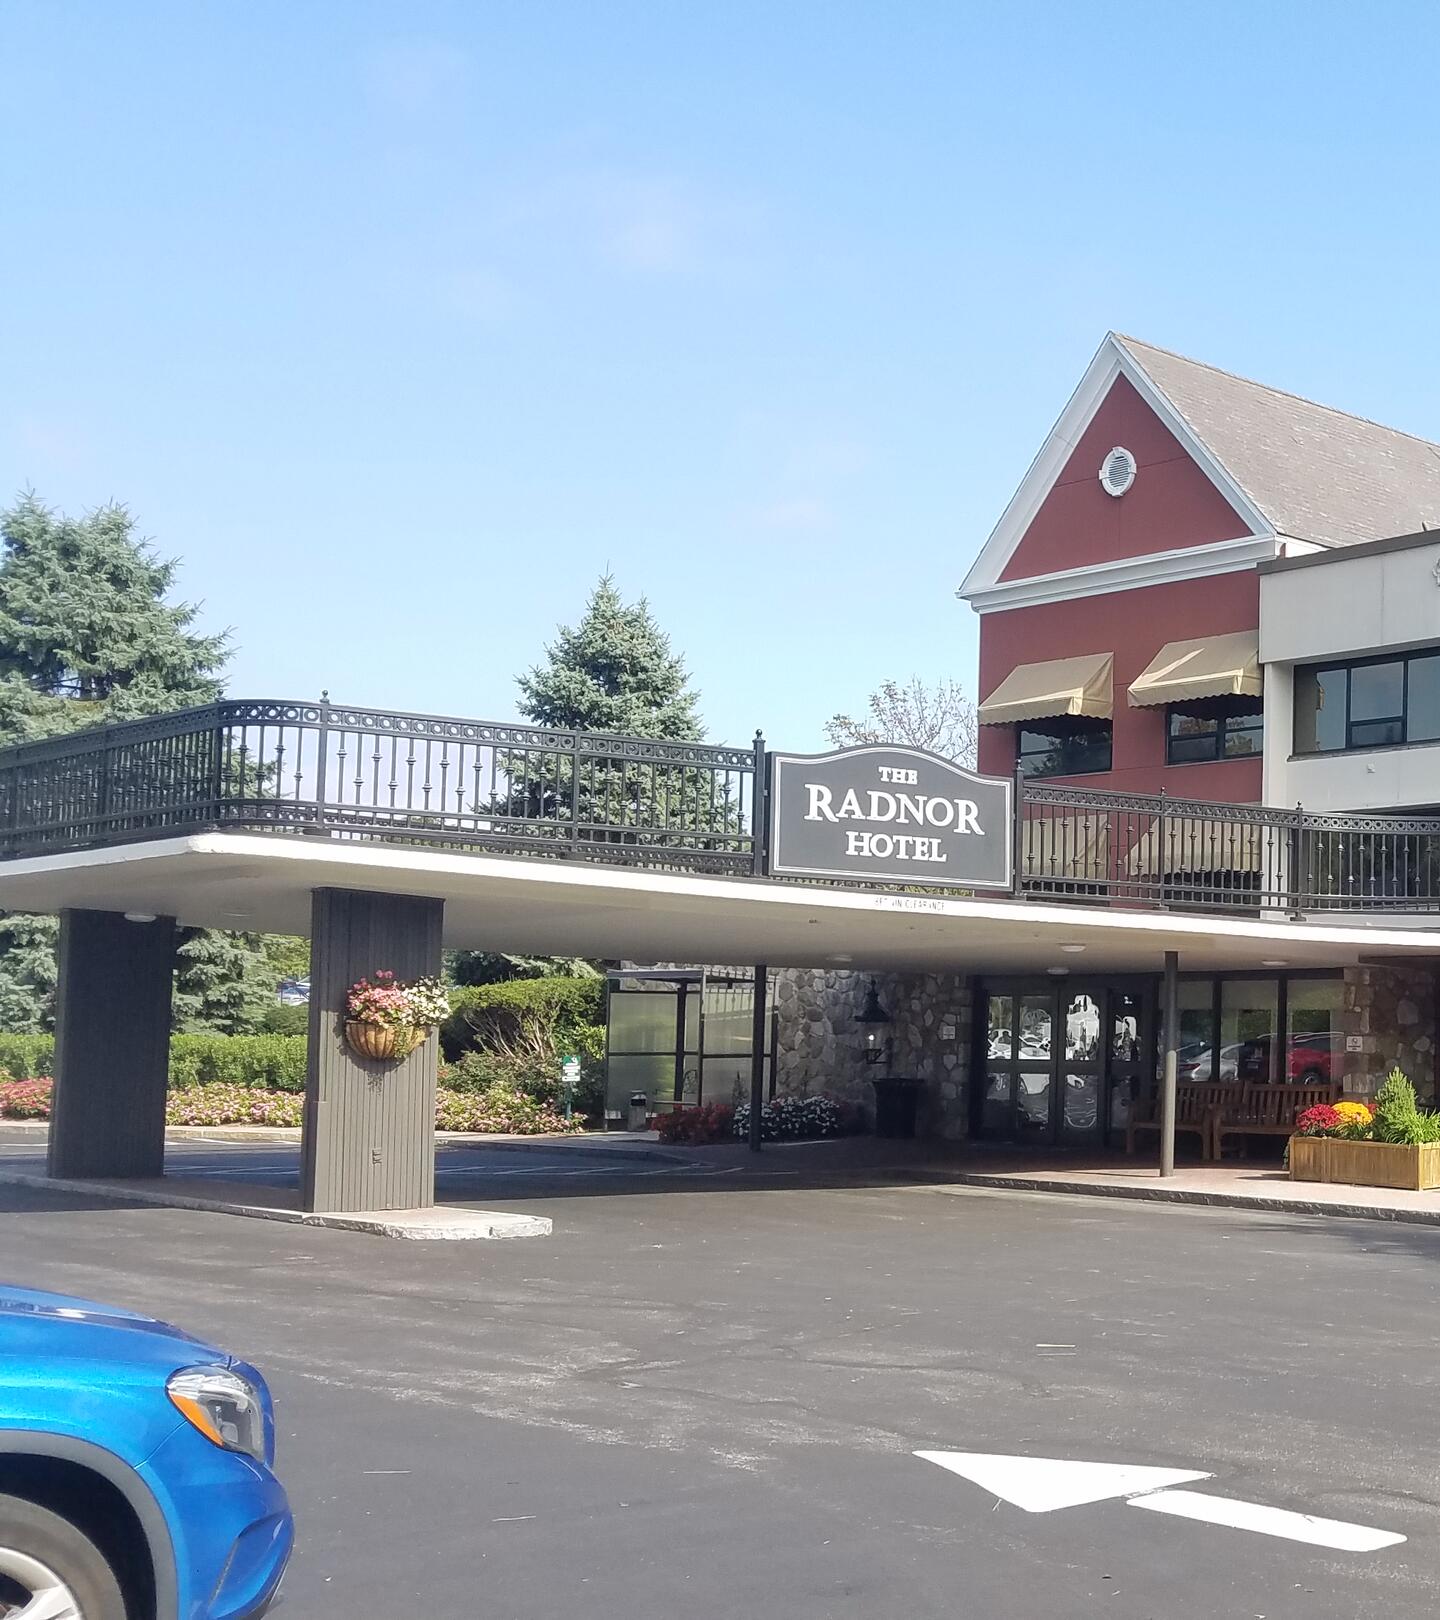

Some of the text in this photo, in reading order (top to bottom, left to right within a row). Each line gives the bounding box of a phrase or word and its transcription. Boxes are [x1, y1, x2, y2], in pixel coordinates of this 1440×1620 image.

[878, 765, 918, 785] THE
[804, 783, 985, 836] RADNOR
[845, 831, 947, 863] HOTEL
